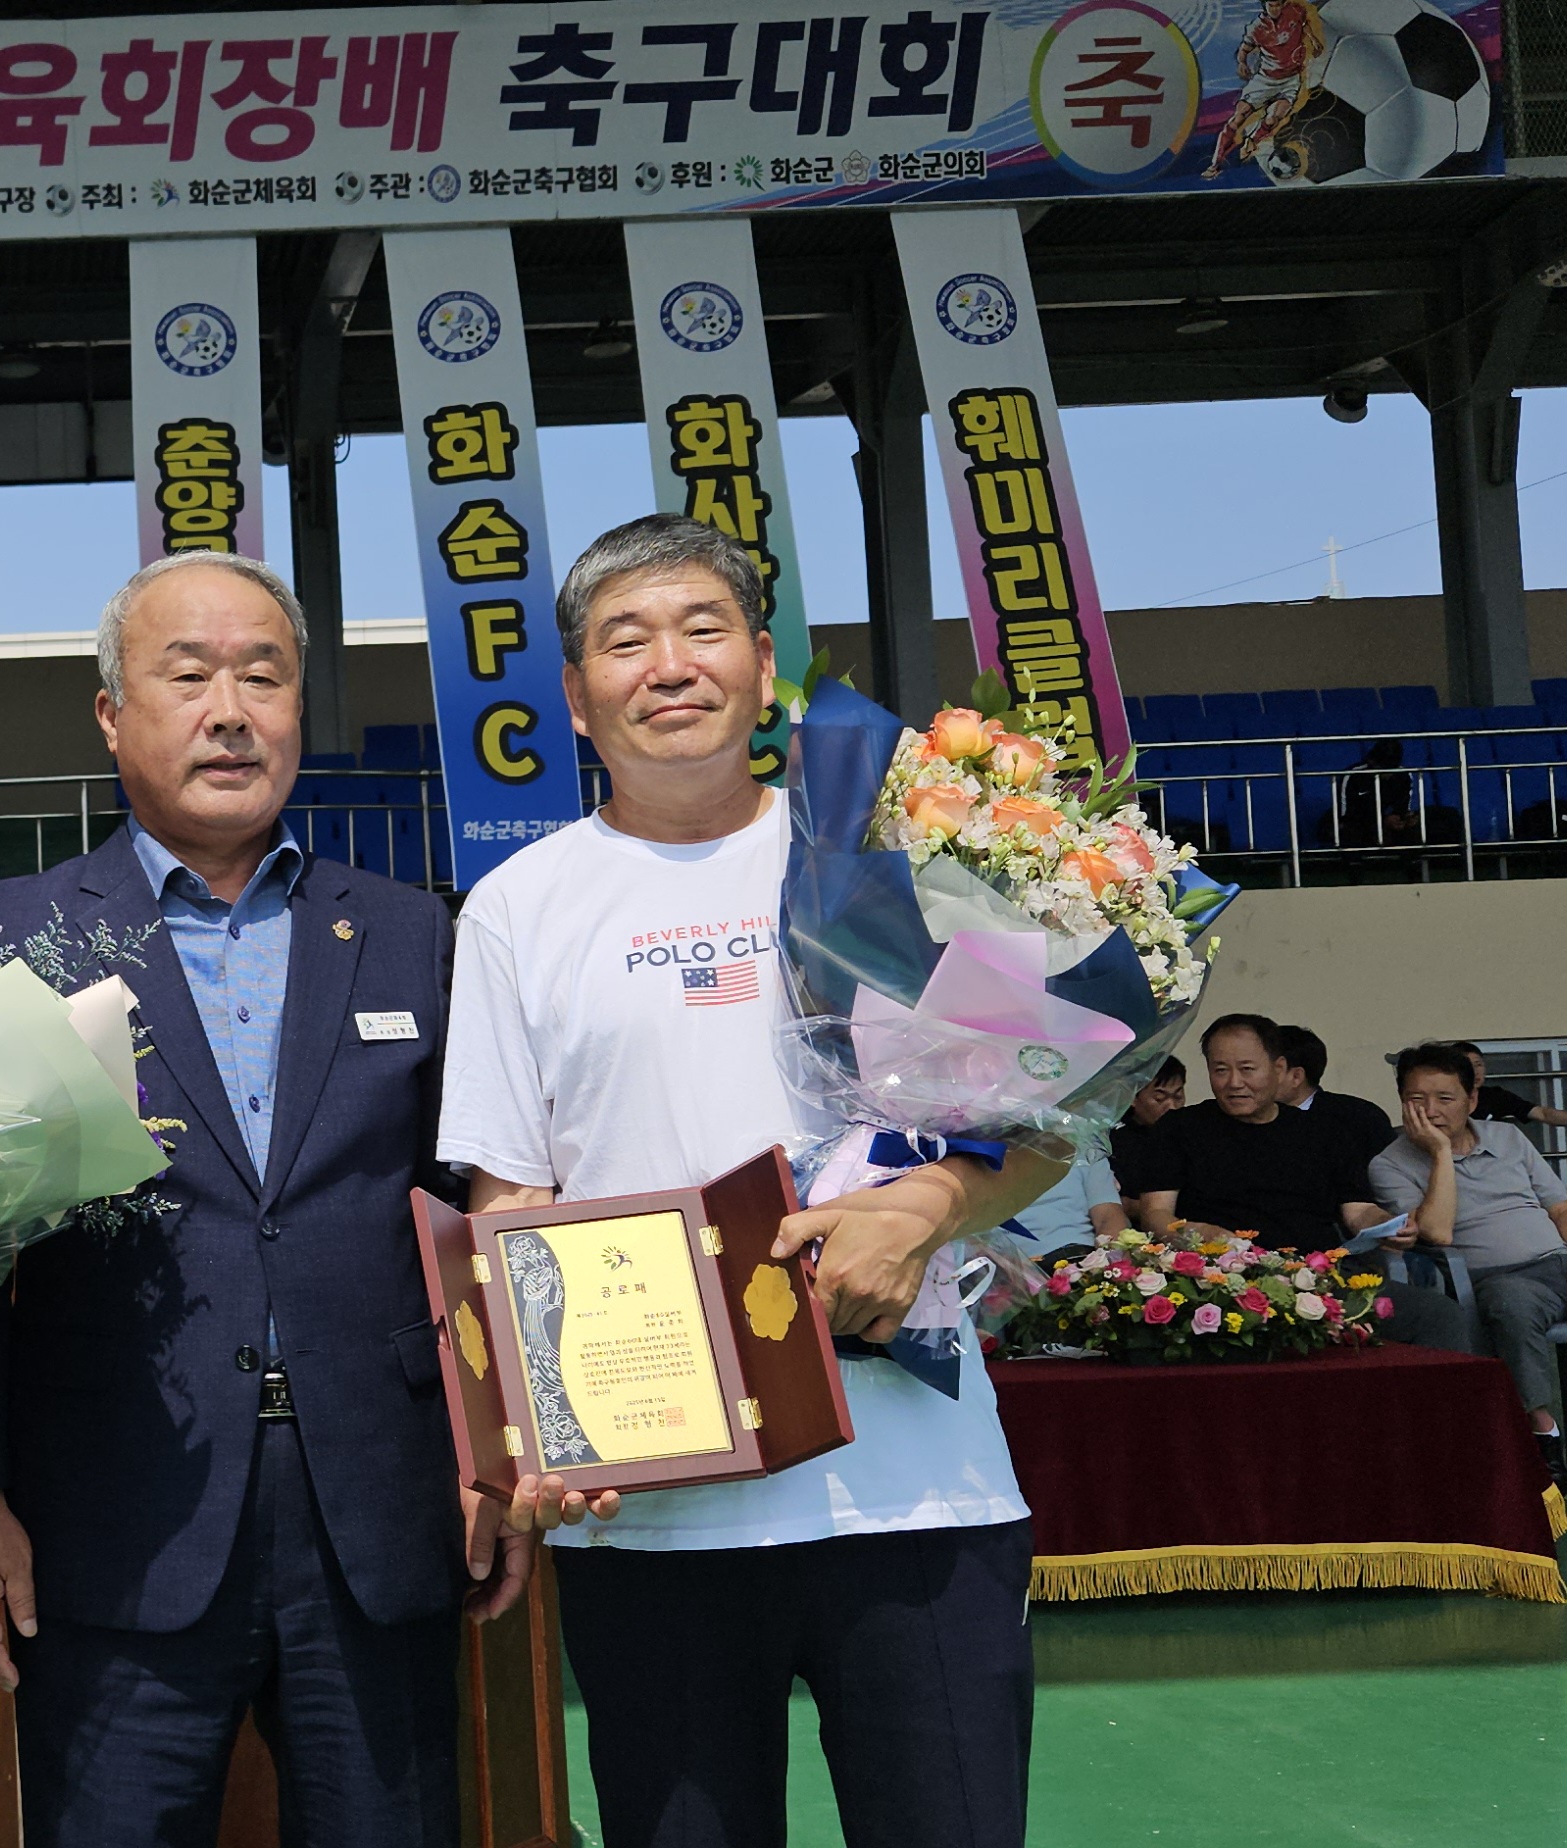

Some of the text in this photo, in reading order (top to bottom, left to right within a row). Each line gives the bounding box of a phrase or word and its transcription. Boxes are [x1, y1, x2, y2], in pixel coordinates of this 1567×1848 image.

[499, 9, 990, 148] 축구대회
[1064, 36, 1165, 152] 축
[369, 173, 411, 201] 주관
[468, 164, 617, 196] 화순군축구협회
[670, 160, 714, 190] 후원
[770, 154, 834, 184] 화순군
[878, 150, 985, 181] 화순군의회
[81, 183, 124, 210] 주최
[189, 176, 317, 207] 화순군체육회
[424, 401, 545, 785] 화순FC
[462, 819, 575, 841] 화순군축구협
[632, 922, 730, 948] BEVERLY
[626, 941, 716, 973] POLO
